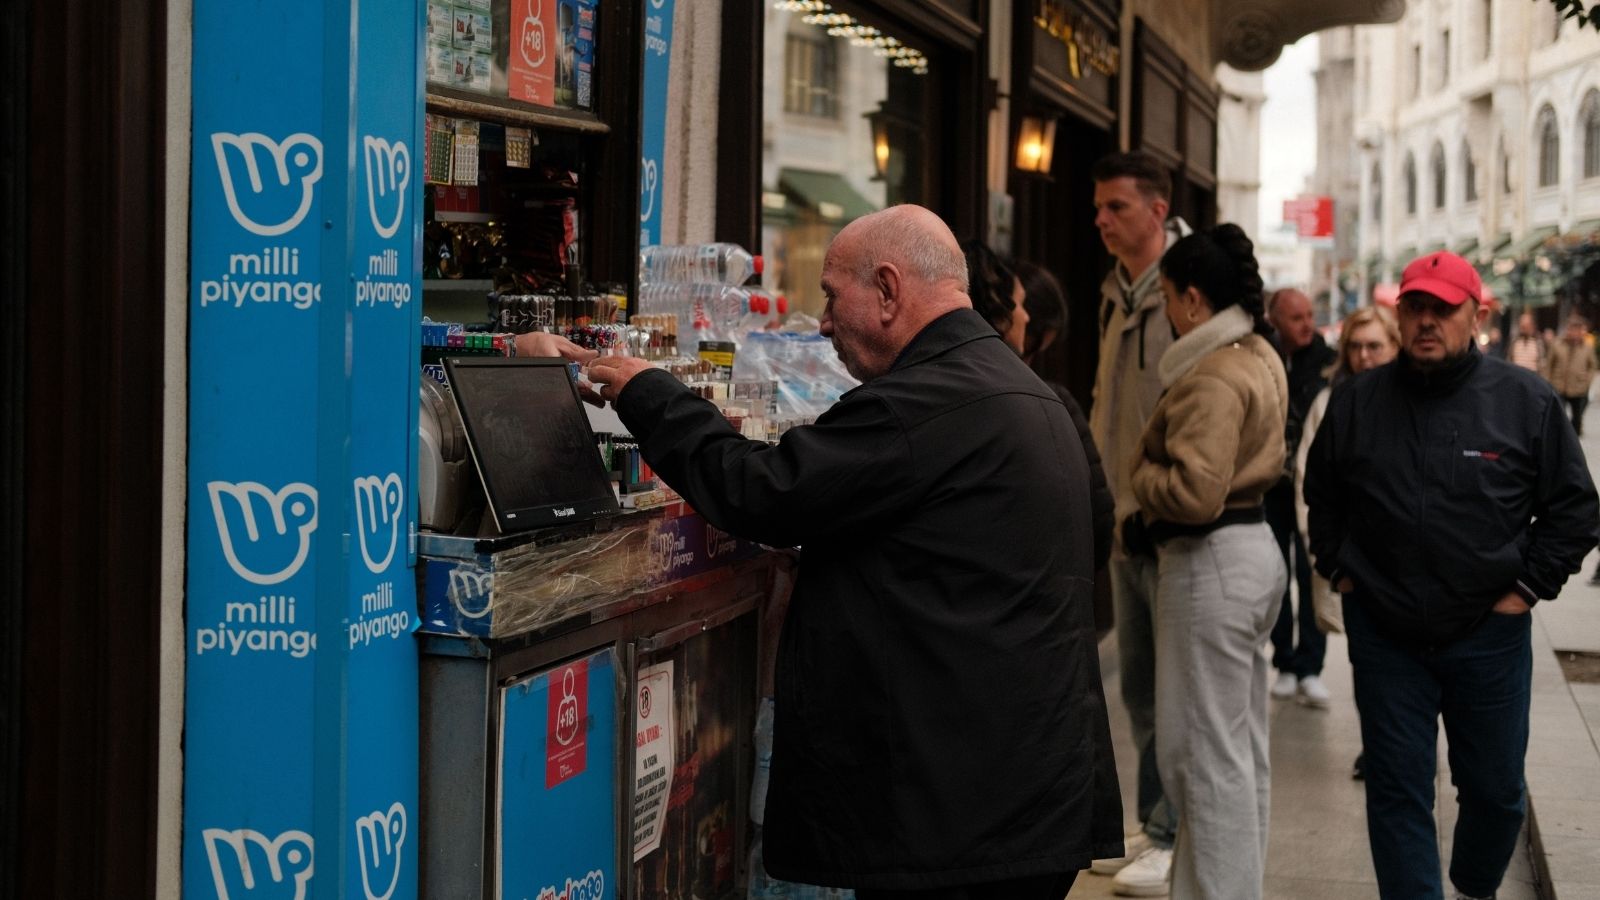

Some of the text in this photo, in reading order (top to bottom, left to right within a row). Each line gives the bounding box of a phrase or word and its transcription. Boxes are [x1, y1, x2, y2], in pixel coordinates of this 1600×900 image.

[525, 30, 541, 51] +18
[229, 247, 299, 275] milli
[369, 249, 398, 276] milli
[356, 275, 411, 309] piyango
[673, 552, 694, 568] piyango
[226, 595, 295, 624] milli
[362, 582, 393, 614] milli
[196, 622, 317, 658] piyang
[349, 611, 409, 650] piyango
[560, 706, 575, 728] +18
